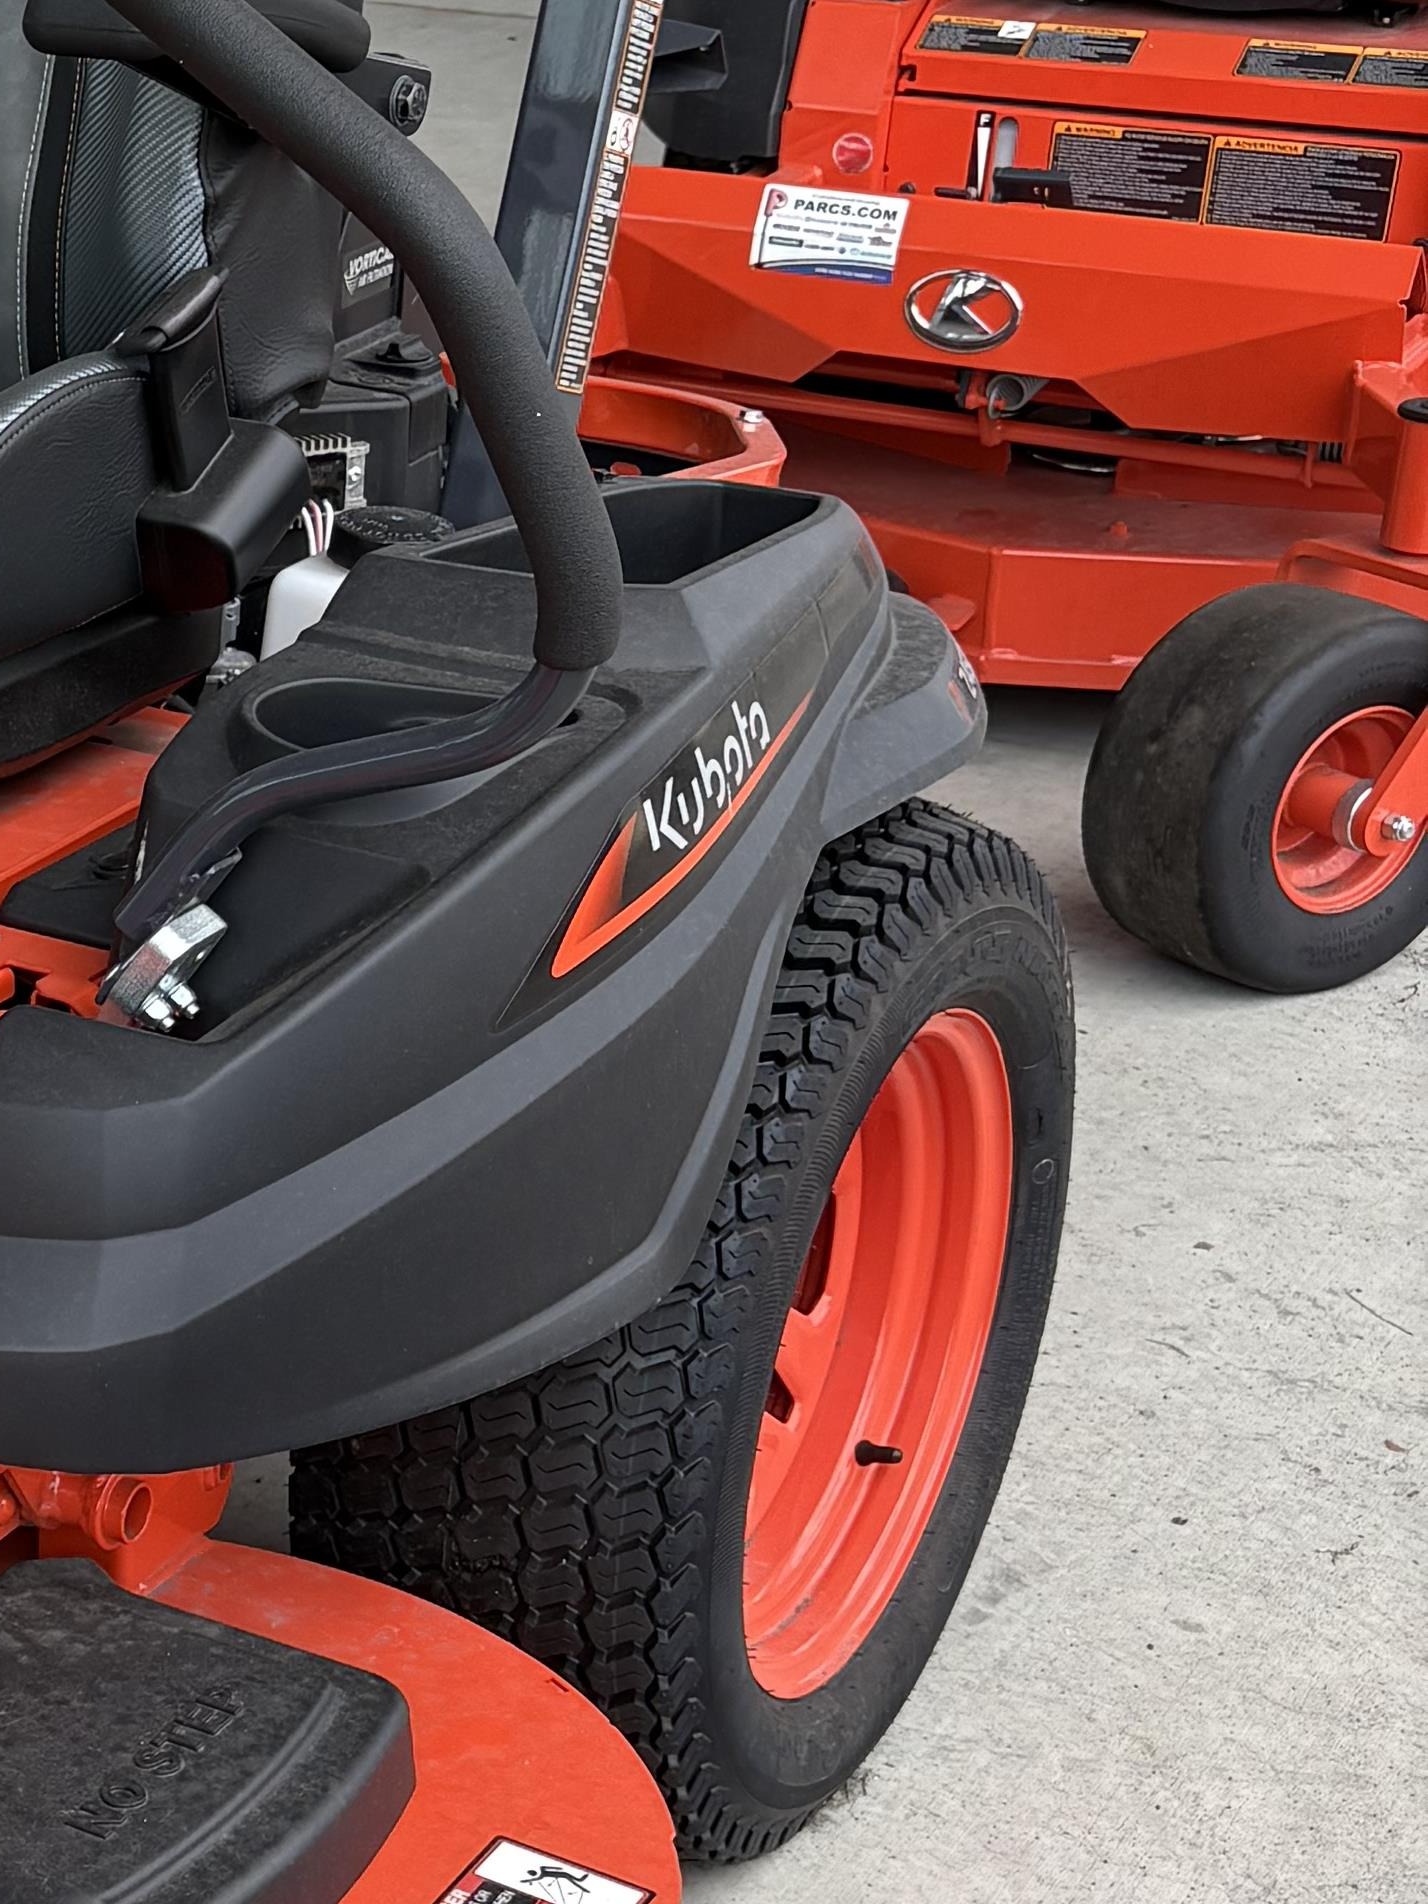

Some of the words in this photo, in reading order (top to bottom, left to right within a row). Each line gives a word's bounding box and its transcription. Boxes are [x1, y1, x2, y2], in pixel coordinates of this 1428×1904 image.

[1235, 140, 1299, 154] ADVERTENCIA
[794, 199, 898, 221] PARCS.COM
[643, 700, 771, 851] Kubota
[63, 1780, 148, 1840] NO
[134, 1683, 246, 1779] STEP
[473, 1888, 492, 1902] OR
